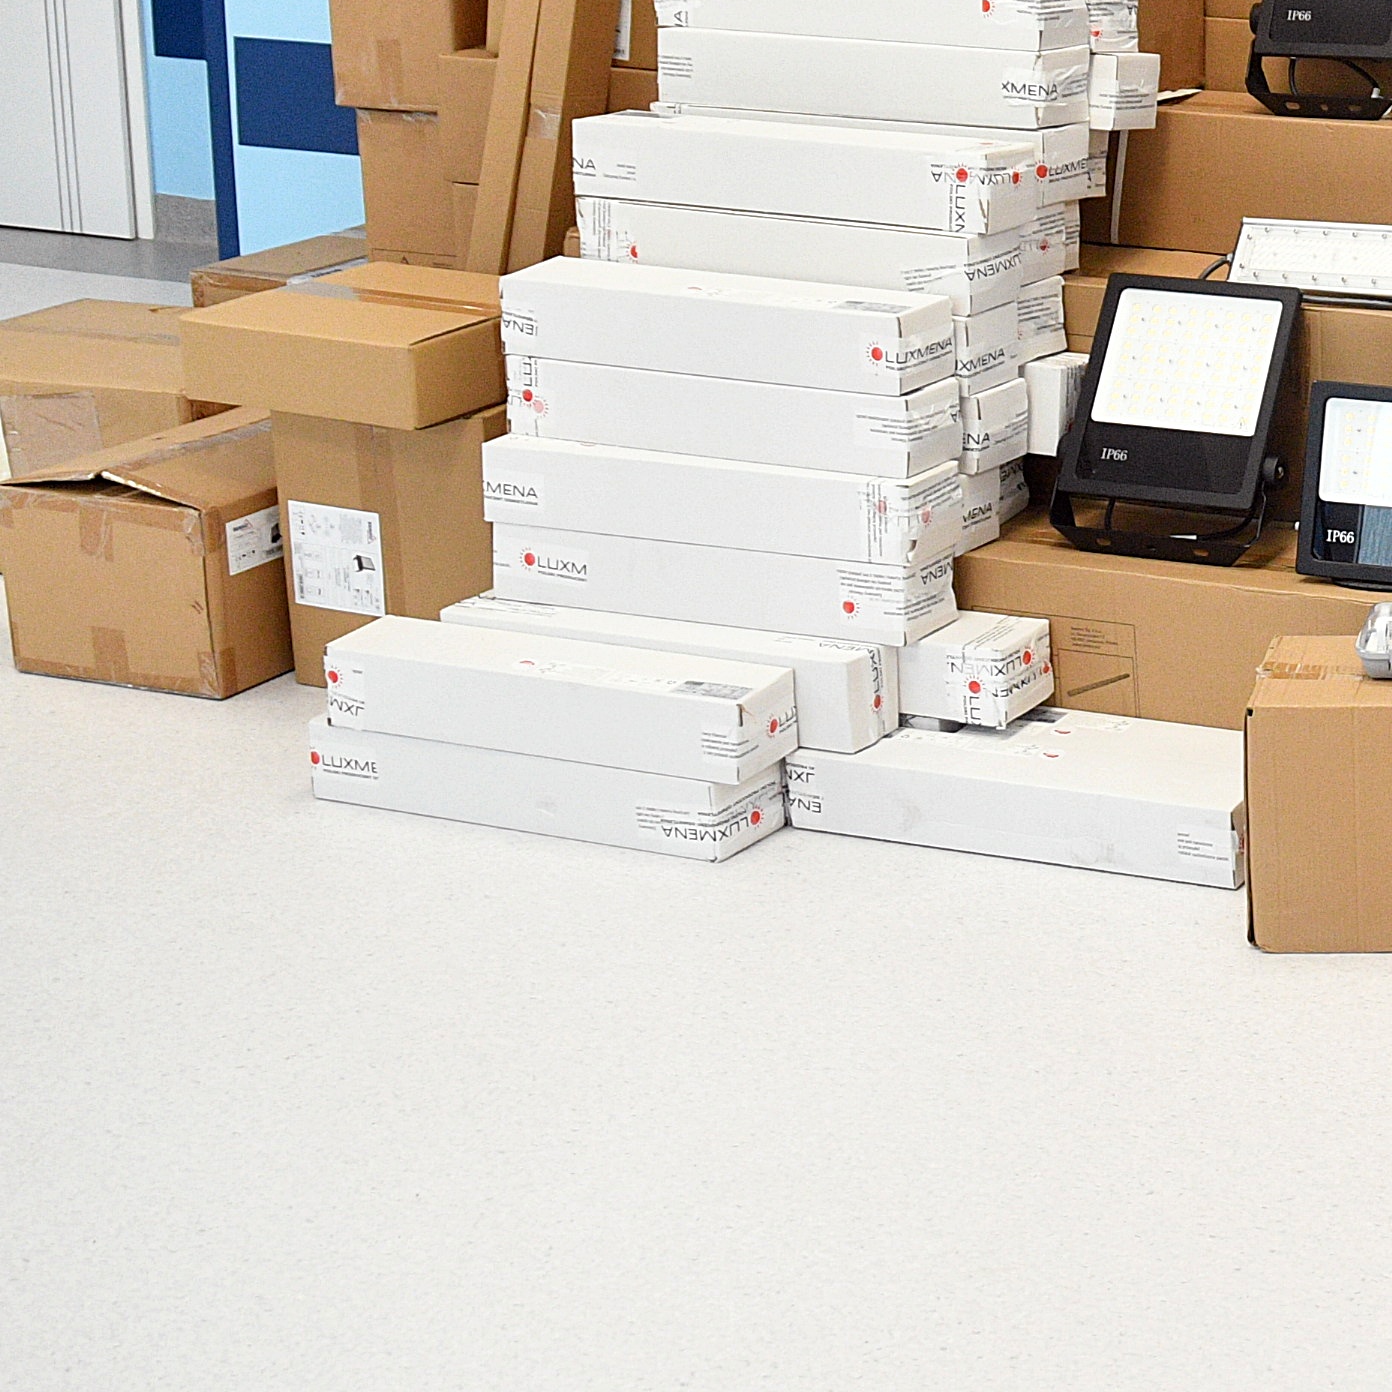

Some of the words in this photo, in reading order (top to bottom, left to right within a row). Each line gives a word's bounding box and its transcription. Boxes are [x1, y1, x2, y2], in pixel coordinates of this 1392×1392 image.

[1286, 9, 1312, 22] IP66
[1001, 80, 1060, 98] XMENA
[1048, 158, 1088, 177] LUXME
[885, 337, 953, 365] LUXMENA
[958, 347, 1006, 372] XMENA
[1099, 447, 1129, 462] IP66
[486, 480, 539, 499] MENA
[1325, 528, 1356, 545] IP66
[537, 555, 588, 576] LUXM
[321, 754, 379, 775] LUXME
[660, 816, 750, 843] LUXMENA
